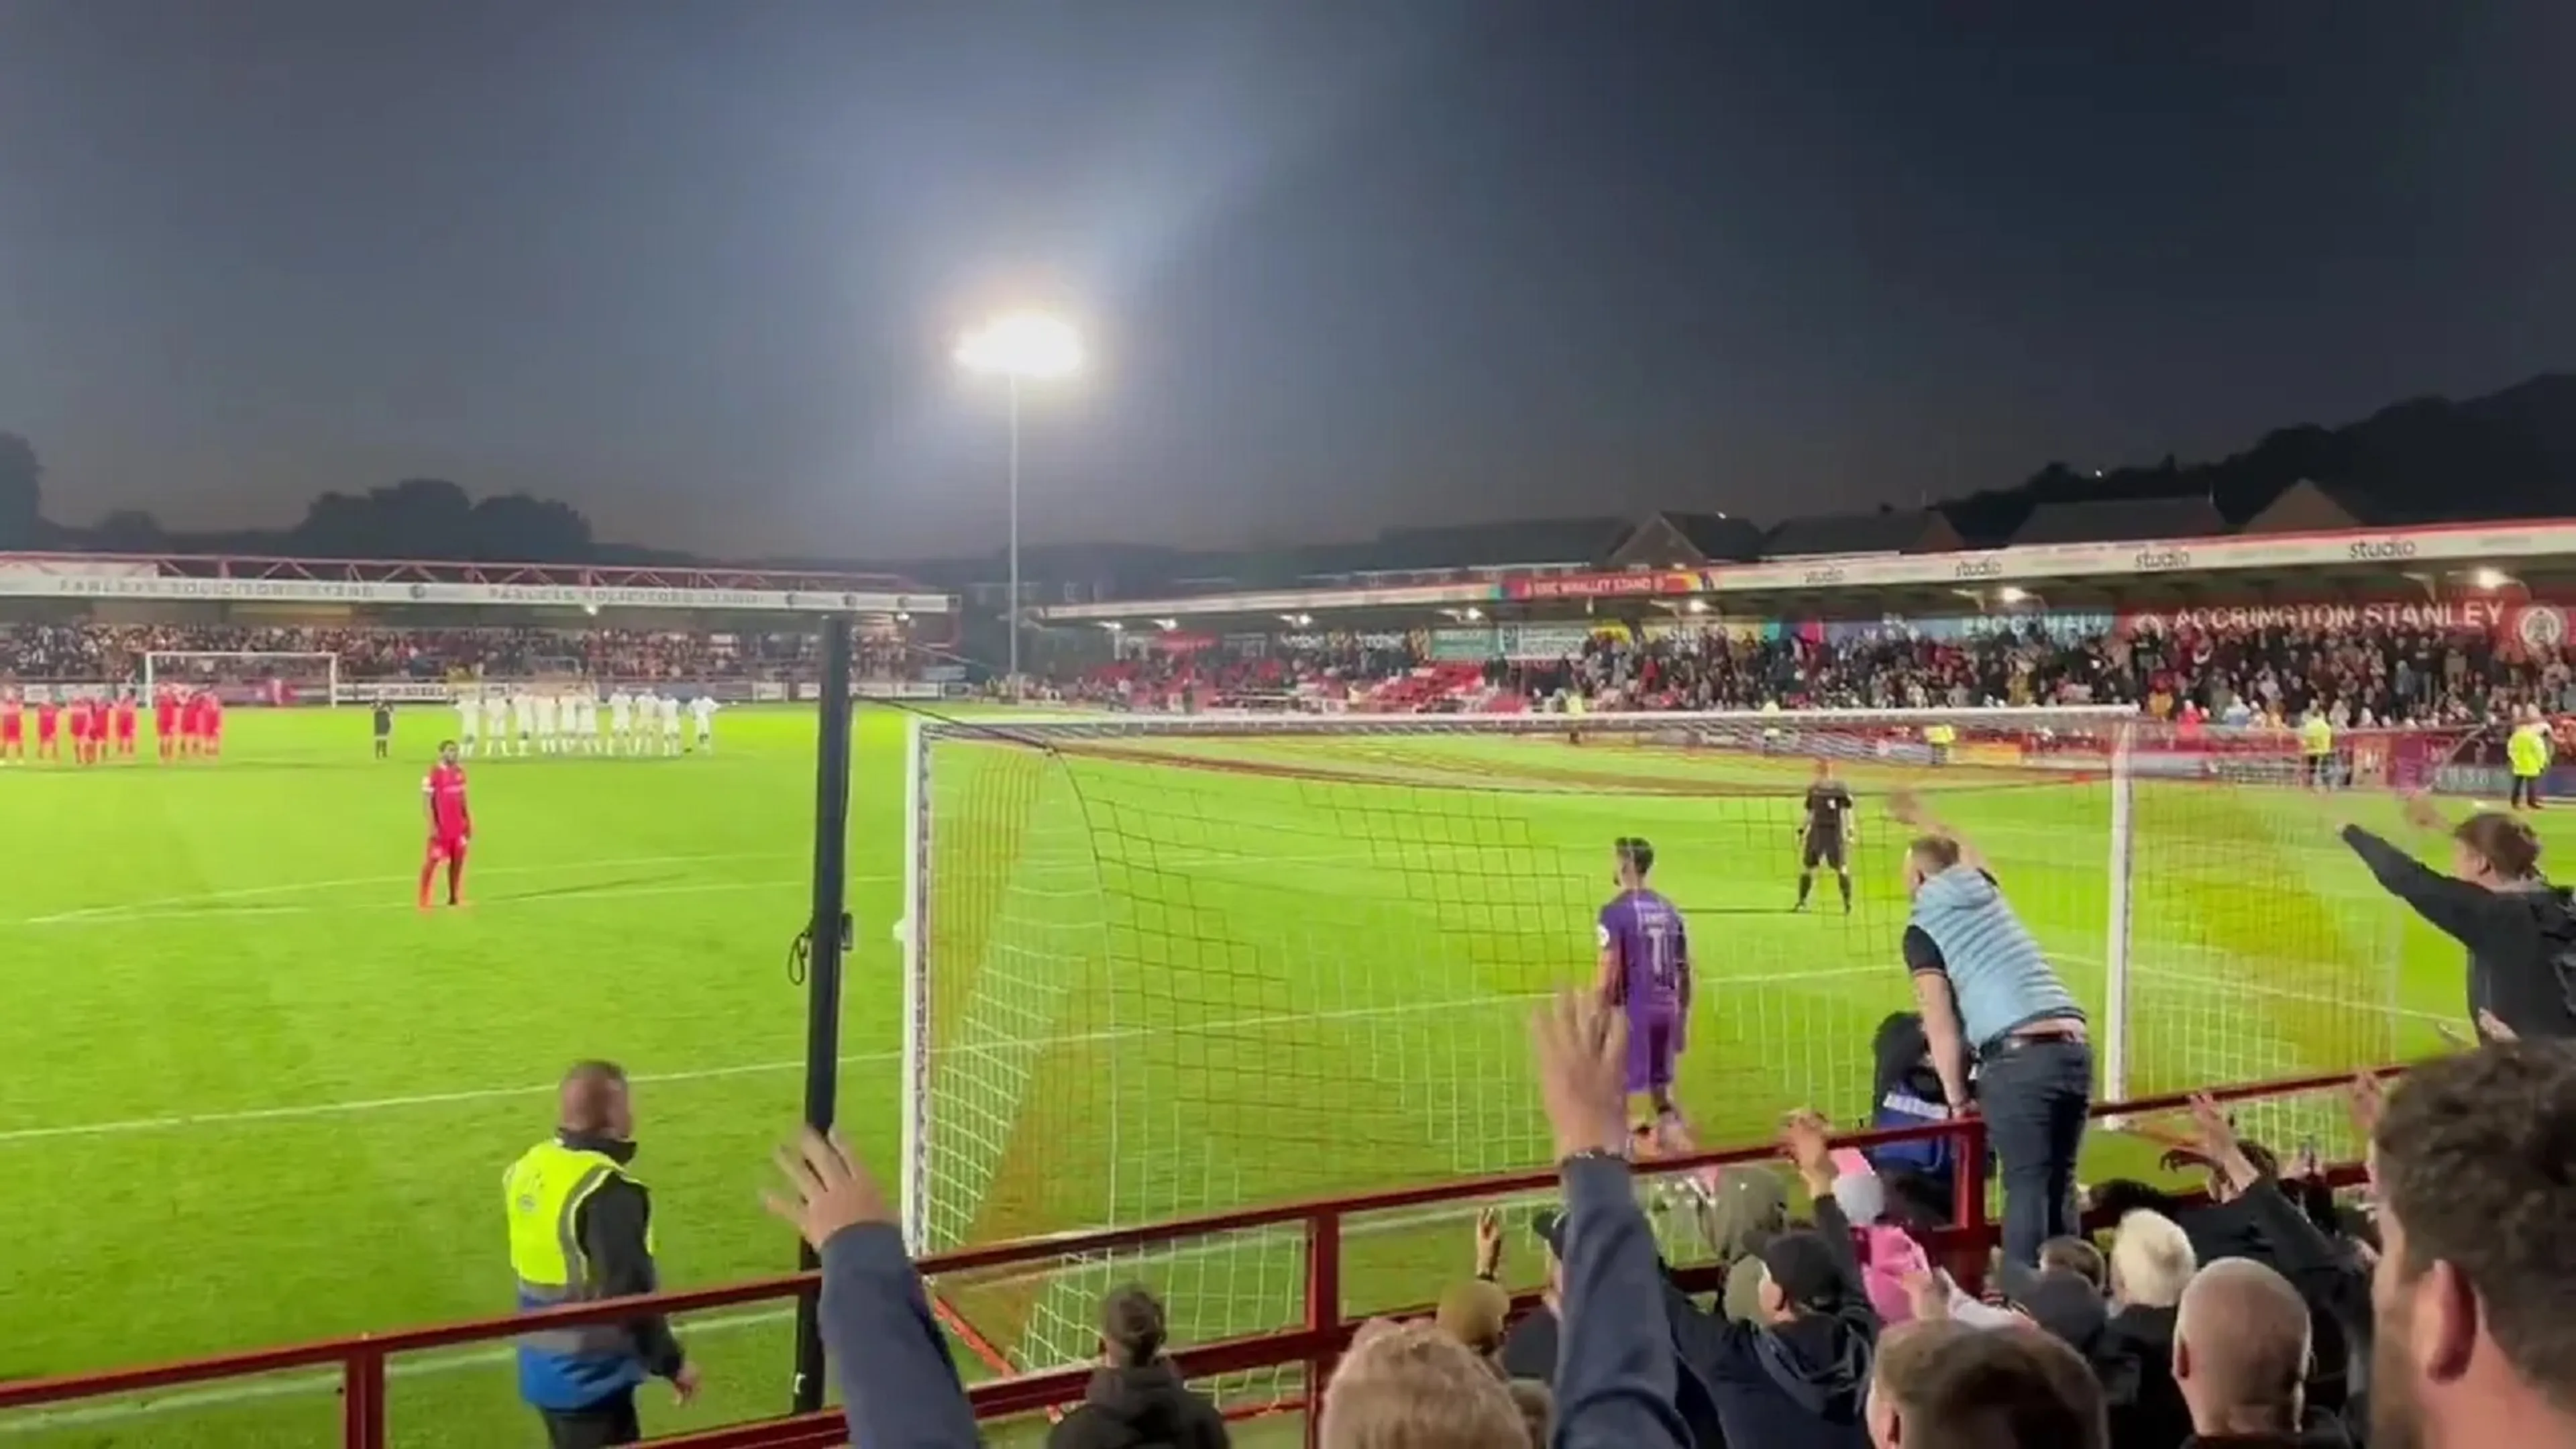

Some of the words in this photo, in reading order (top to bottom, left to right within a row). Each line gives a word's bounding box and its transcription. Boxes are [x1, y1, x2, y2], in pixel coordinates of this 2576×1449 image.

[2349, 538, 2416, 558] studio
[2175, 606, 2355, 629] ACCRINGTON
[2365, 601, 2504, 627] STANLEY
